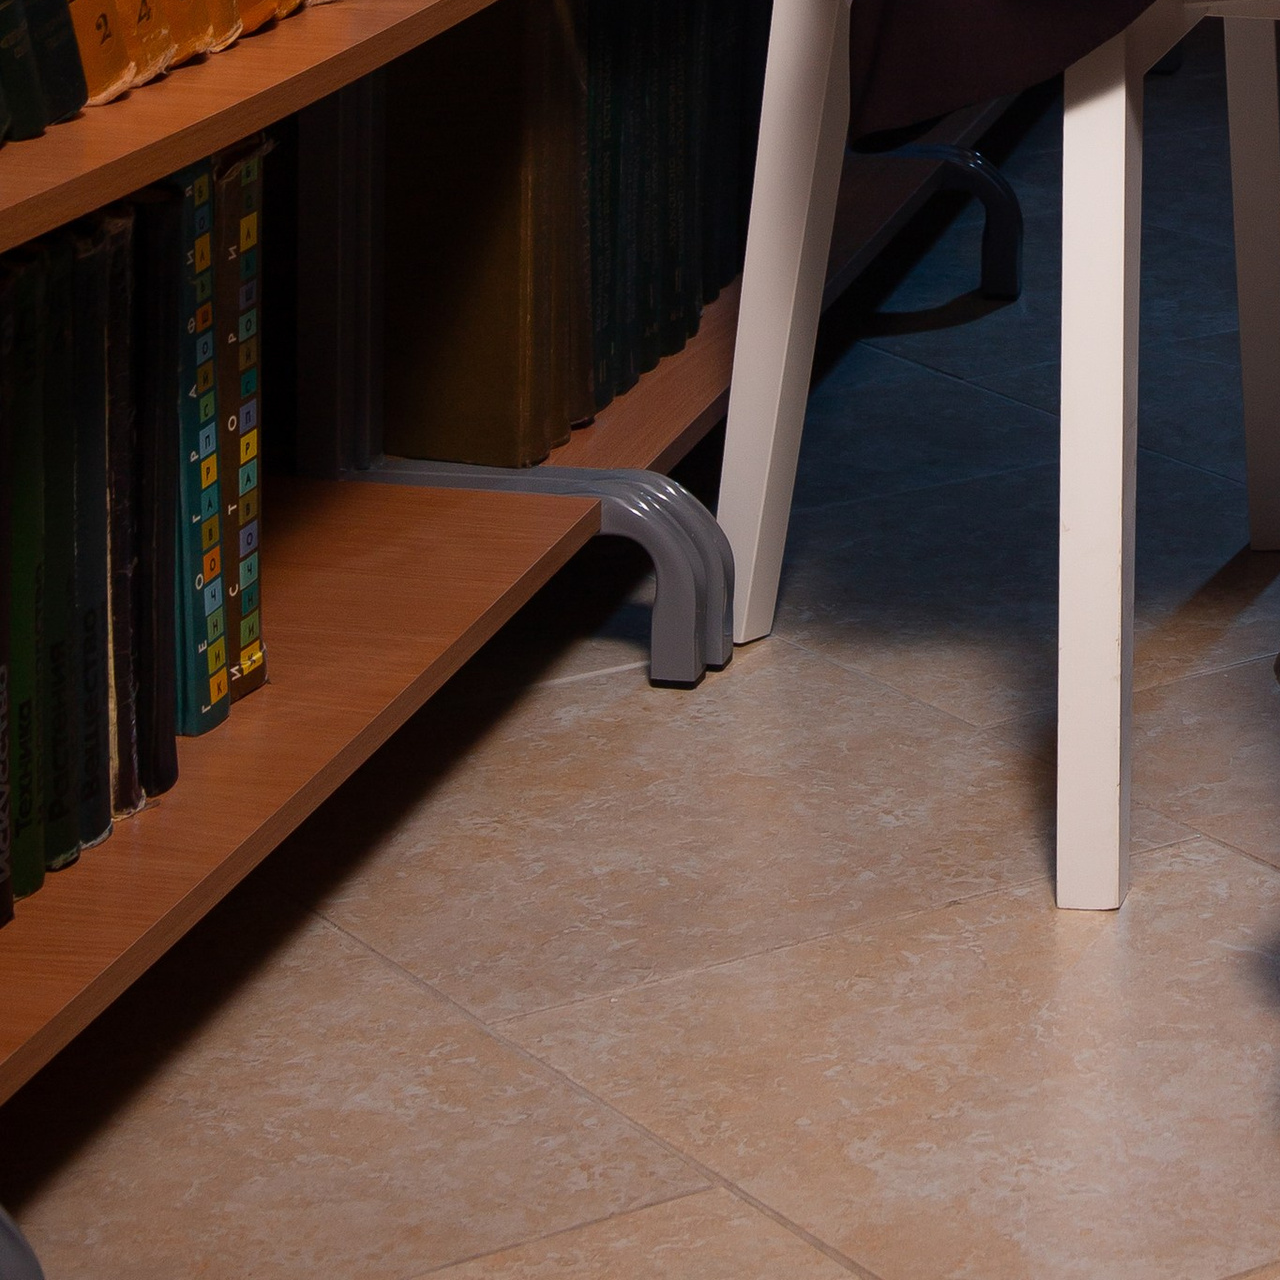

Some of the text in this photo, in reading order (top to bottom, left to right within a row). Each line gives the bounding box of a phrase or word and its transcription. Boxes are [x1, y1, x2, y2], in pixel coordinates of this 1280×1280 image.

[95, 13, 112, 46] 2
[15, 698, 33, 839] Техника
[48, 639, 70, 824] Растения
[81, 608, 102, 802] Вещество
